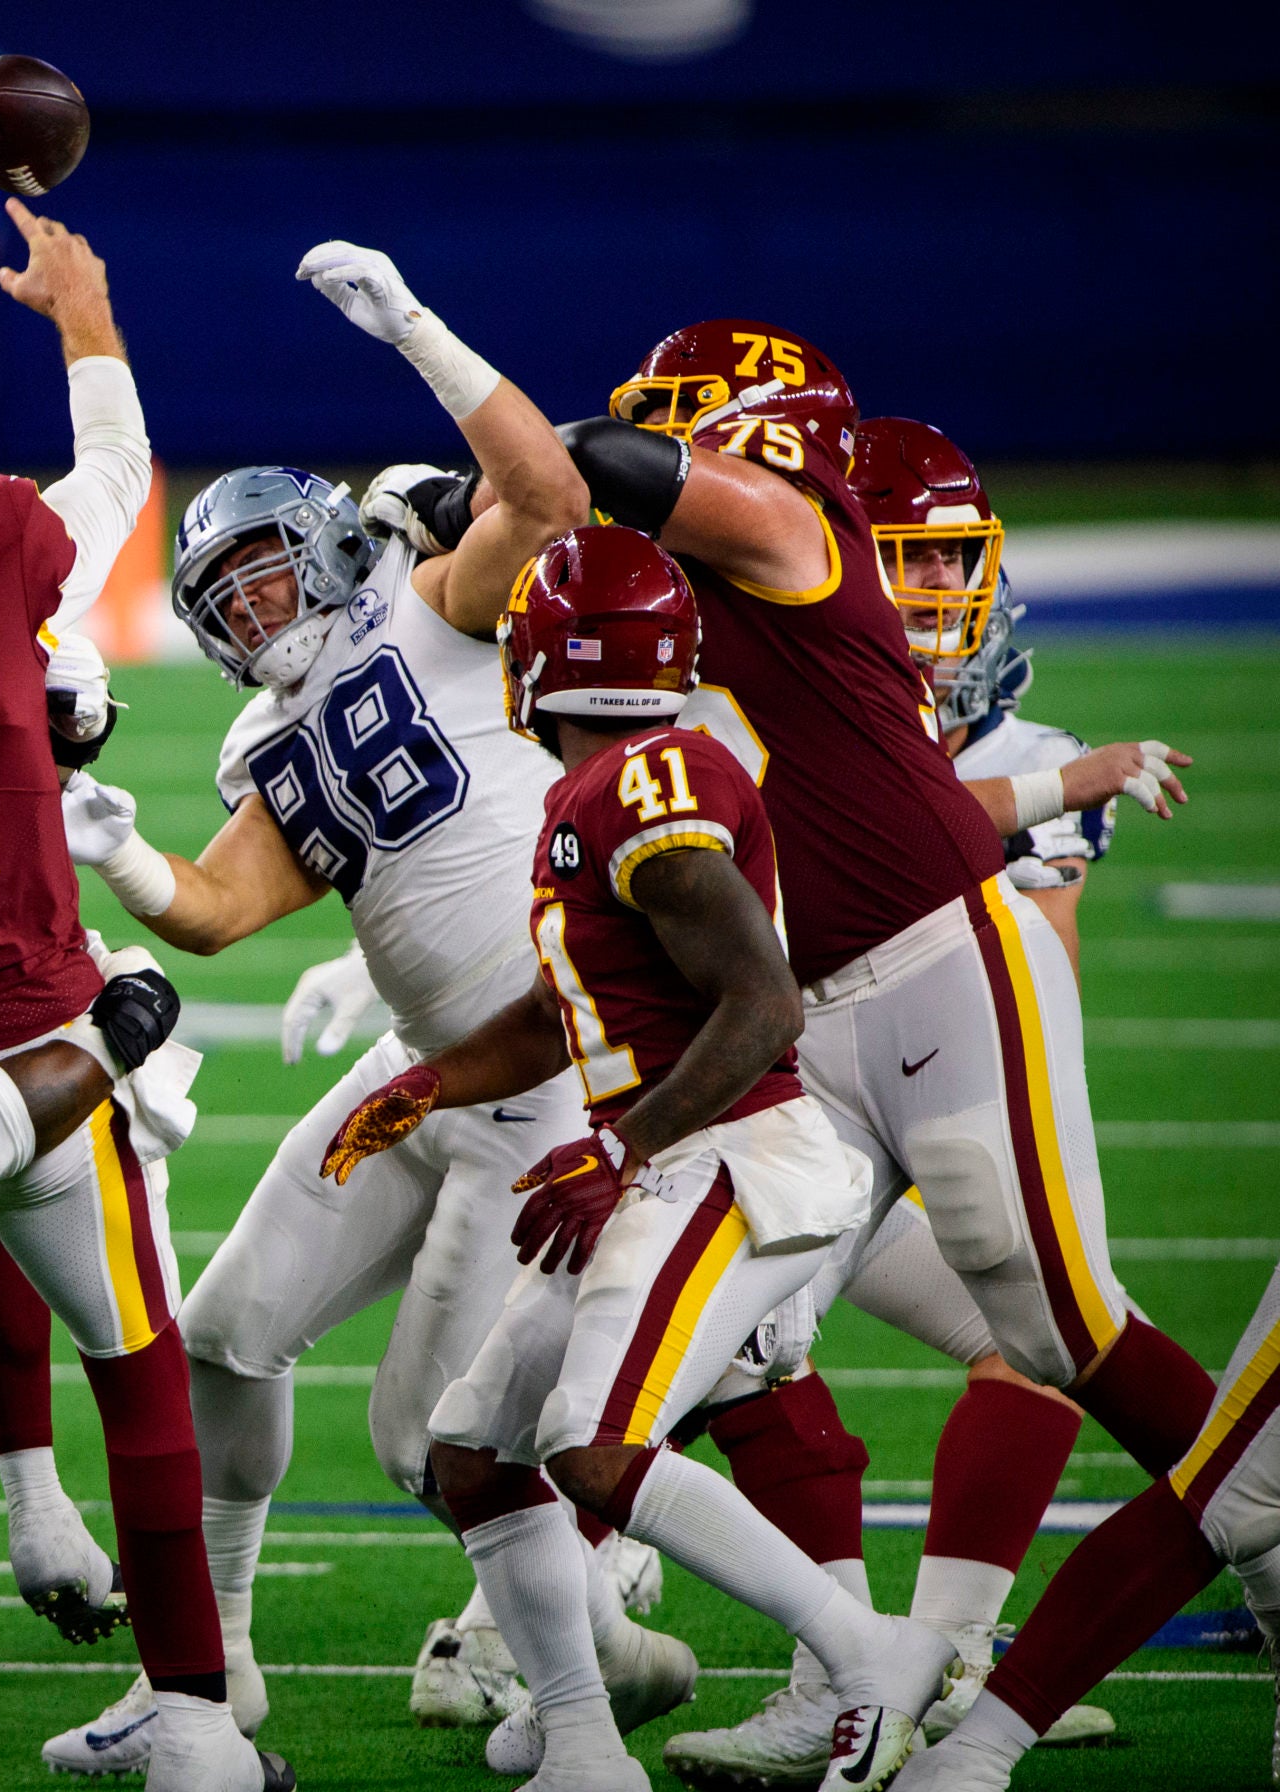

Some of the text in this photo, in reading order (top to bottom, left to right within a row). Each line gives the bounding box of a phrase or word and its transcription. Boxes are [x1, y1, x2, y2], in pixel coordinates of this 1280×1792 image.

[732, 332, 806, 387] 75
[717, 418, 804, 471] 75
[590, 697, 662, 706] IT TAKES ALL OF US
[618, 747, 698, 822] 41
[551, 833, 579, 868] 49
